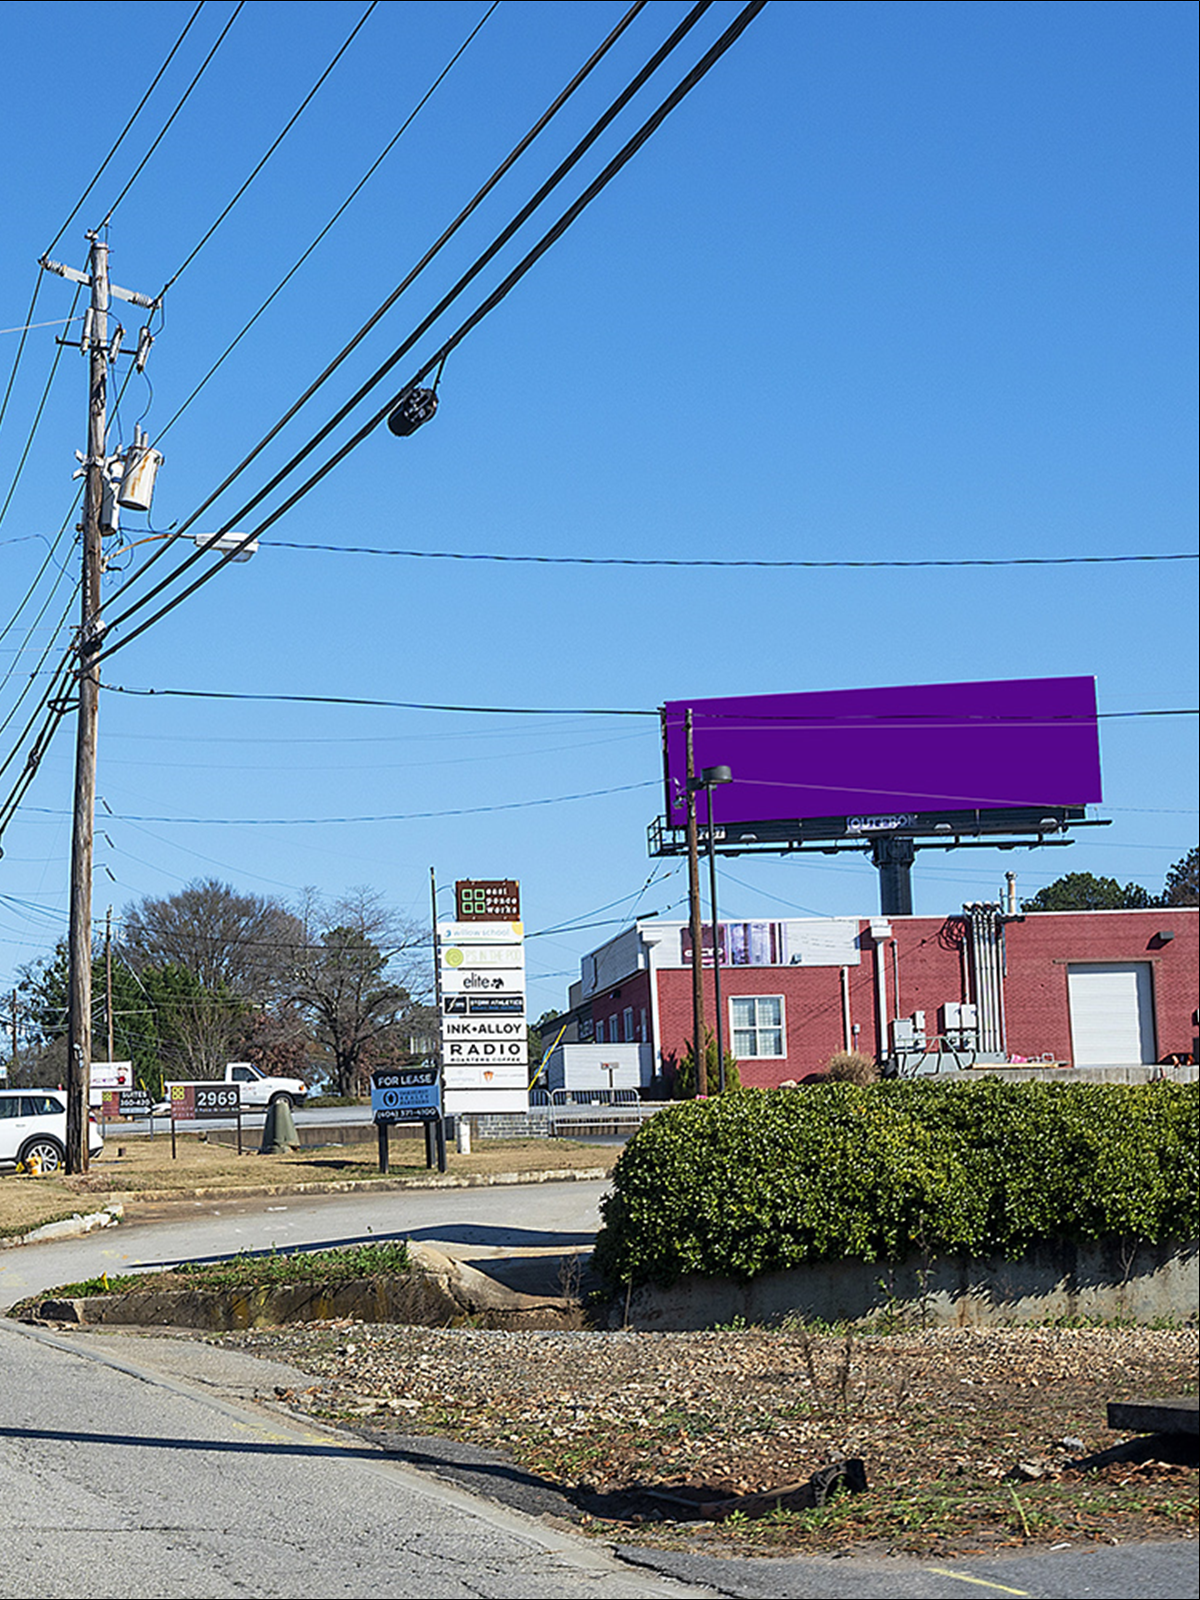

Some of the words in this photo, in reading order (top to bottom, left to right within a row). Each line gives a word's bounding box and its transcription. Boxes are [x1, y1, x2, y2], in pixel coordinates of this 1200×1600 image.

[482, 928, 510, 936] school
[463, 972, 490, 989] elite
[450, 1043, 521, 1055] RADIO
[378, 1076, 399, 1086] FOR
[400, 1073, 432, 1085] LEASE
[197, 1091, 238, 1106] 2969
